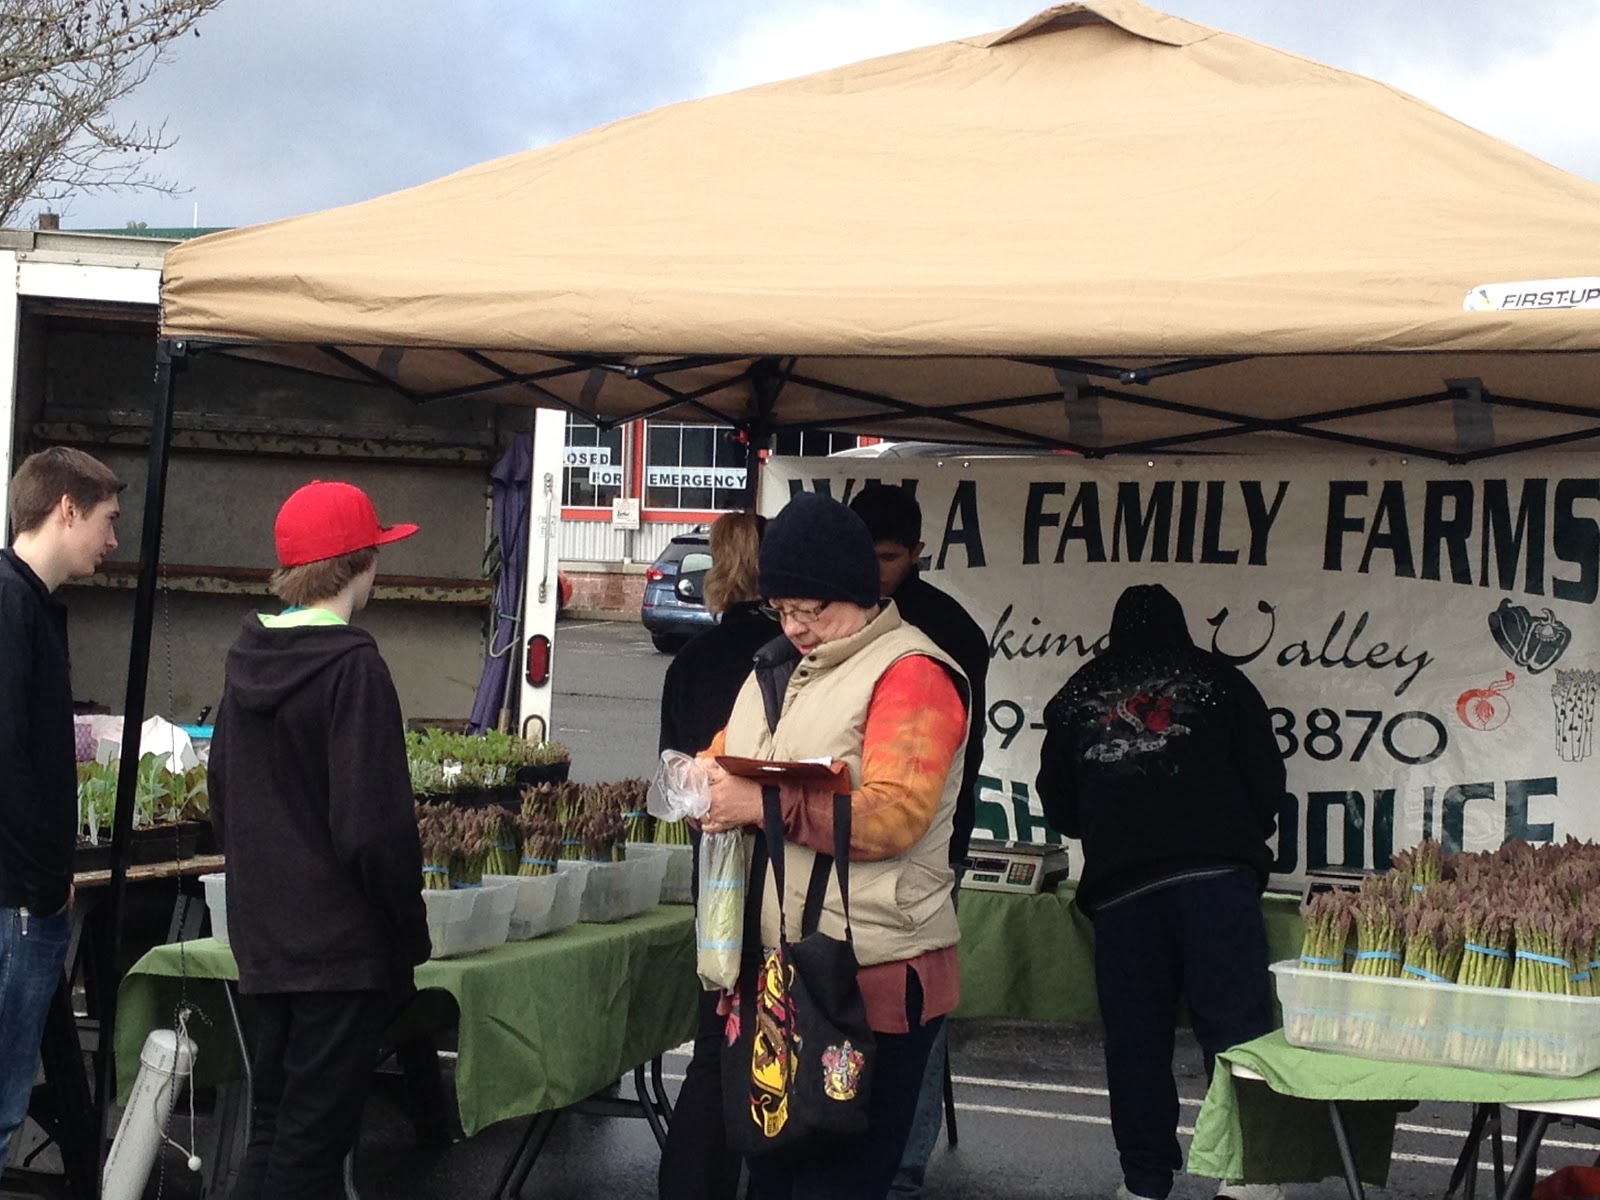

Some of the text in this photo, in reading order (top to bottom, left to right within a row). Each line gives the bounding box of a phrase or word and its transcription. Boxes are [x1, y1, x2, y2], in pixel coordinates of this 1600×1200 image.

[563, 452, 609, 465] OSED
[592, 472, 747, 489] FOR EMERGENCY
[1023, 480, 1290, 566] FAMILY
[1323, 478, 1600, 604] FARMS
[1206, 600, 1436, 697] Valley
